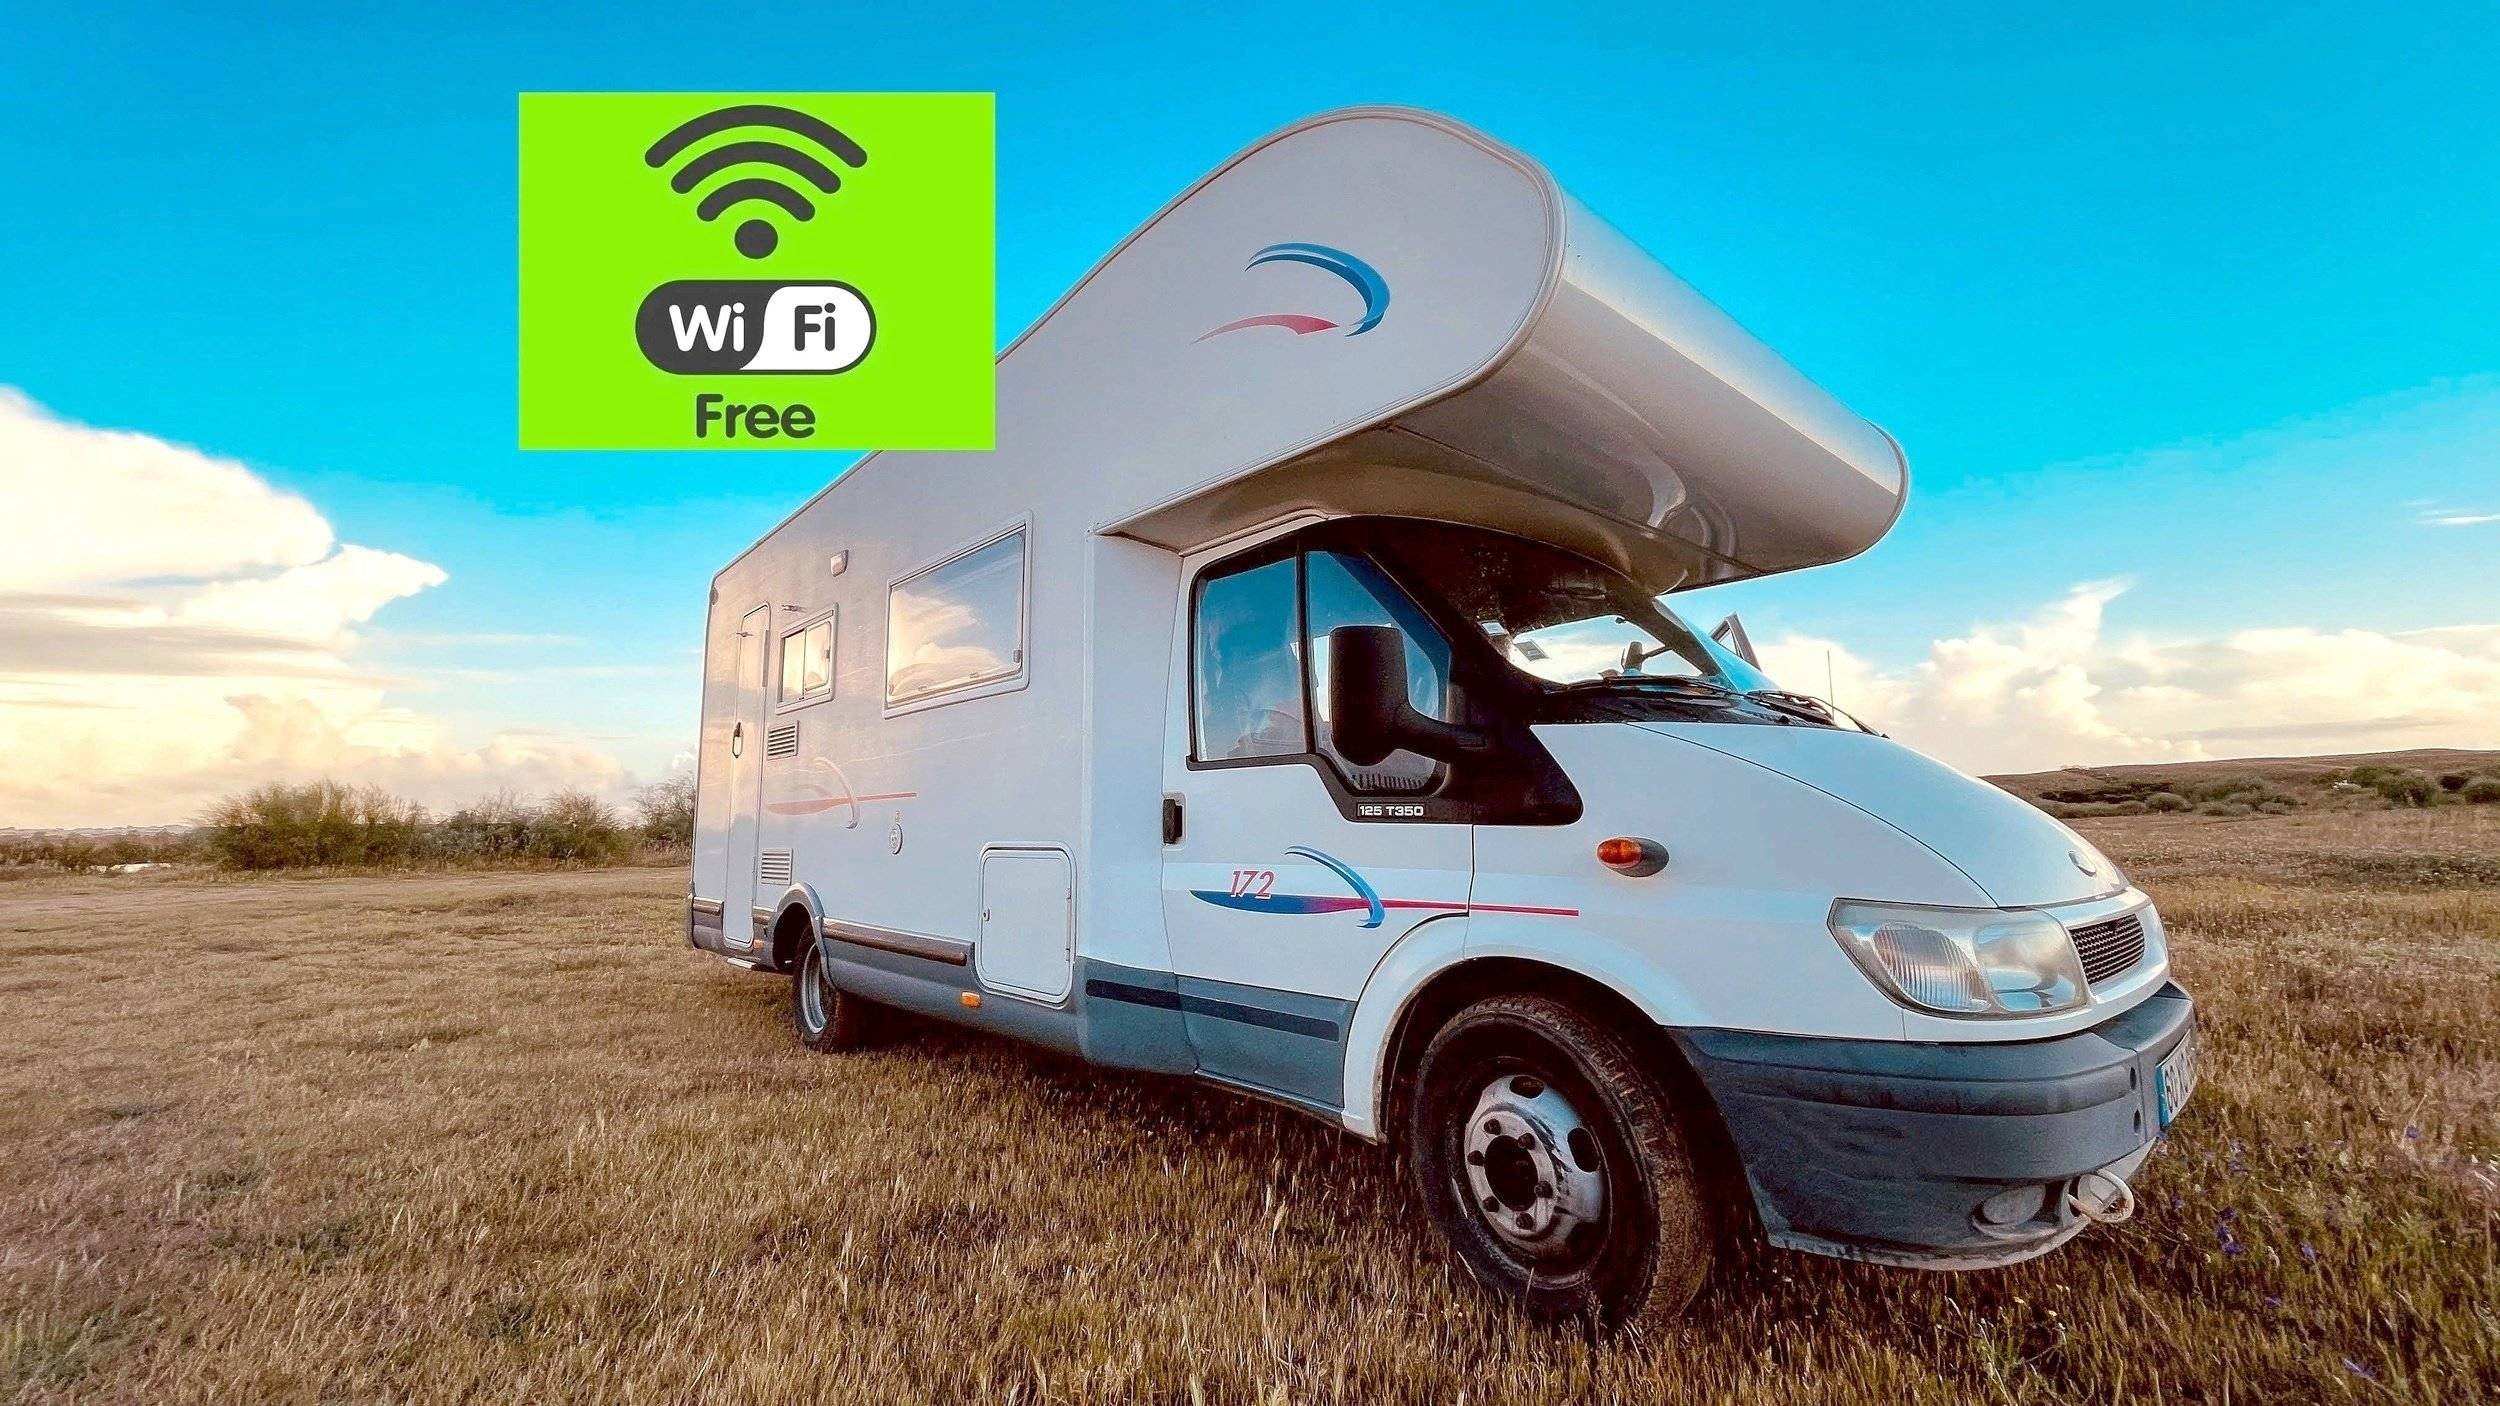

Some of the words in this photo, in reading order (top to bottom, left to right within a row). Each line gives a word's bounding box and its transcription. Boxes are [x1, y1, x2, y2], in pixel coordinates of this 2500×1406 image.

[1359, 805, 1383, 816] 125
[1385, 805, 1424, 817] T350
[1229, 870, 1276, 899] 172
